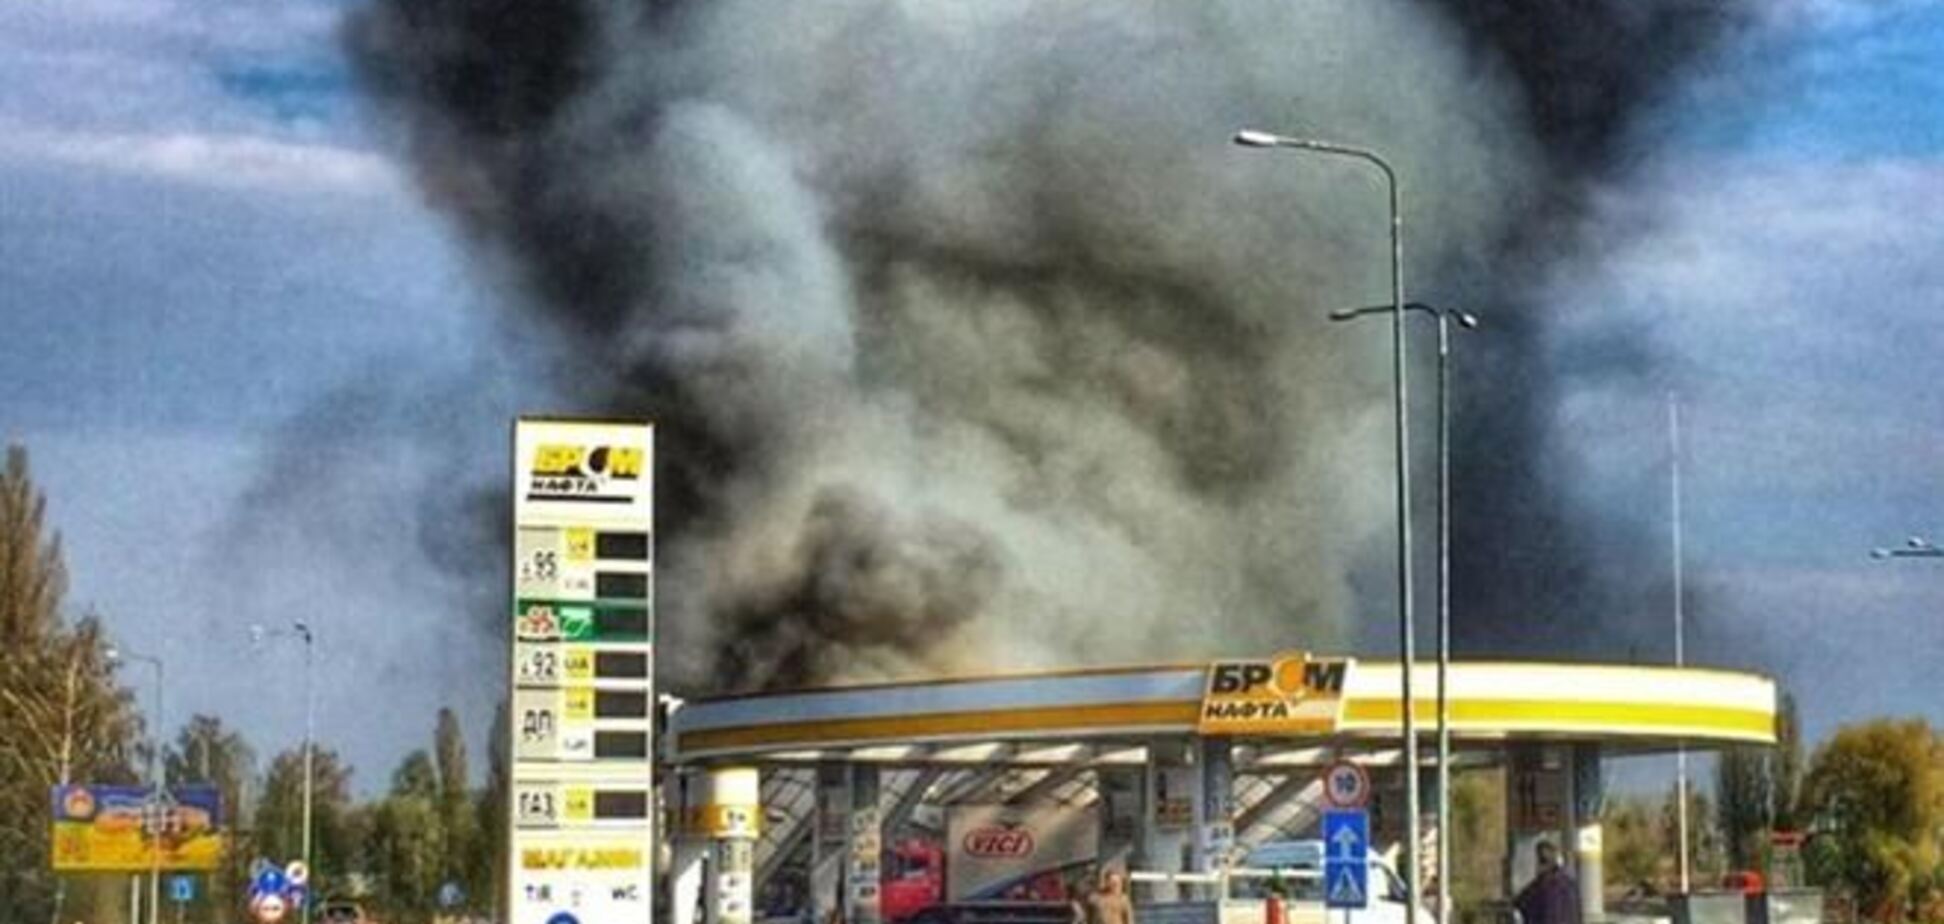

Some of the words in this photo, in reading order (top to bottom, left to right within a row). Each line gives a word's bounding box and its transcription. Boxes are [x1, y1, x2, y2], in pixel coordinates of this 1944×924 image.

[531, 480, 598, 492] НАФТА
[1210, 655, 1347, 694] БРОМ
[1206, 702, 1288, 718] НАФТА
[974, 834, 1024, 853] VICI
